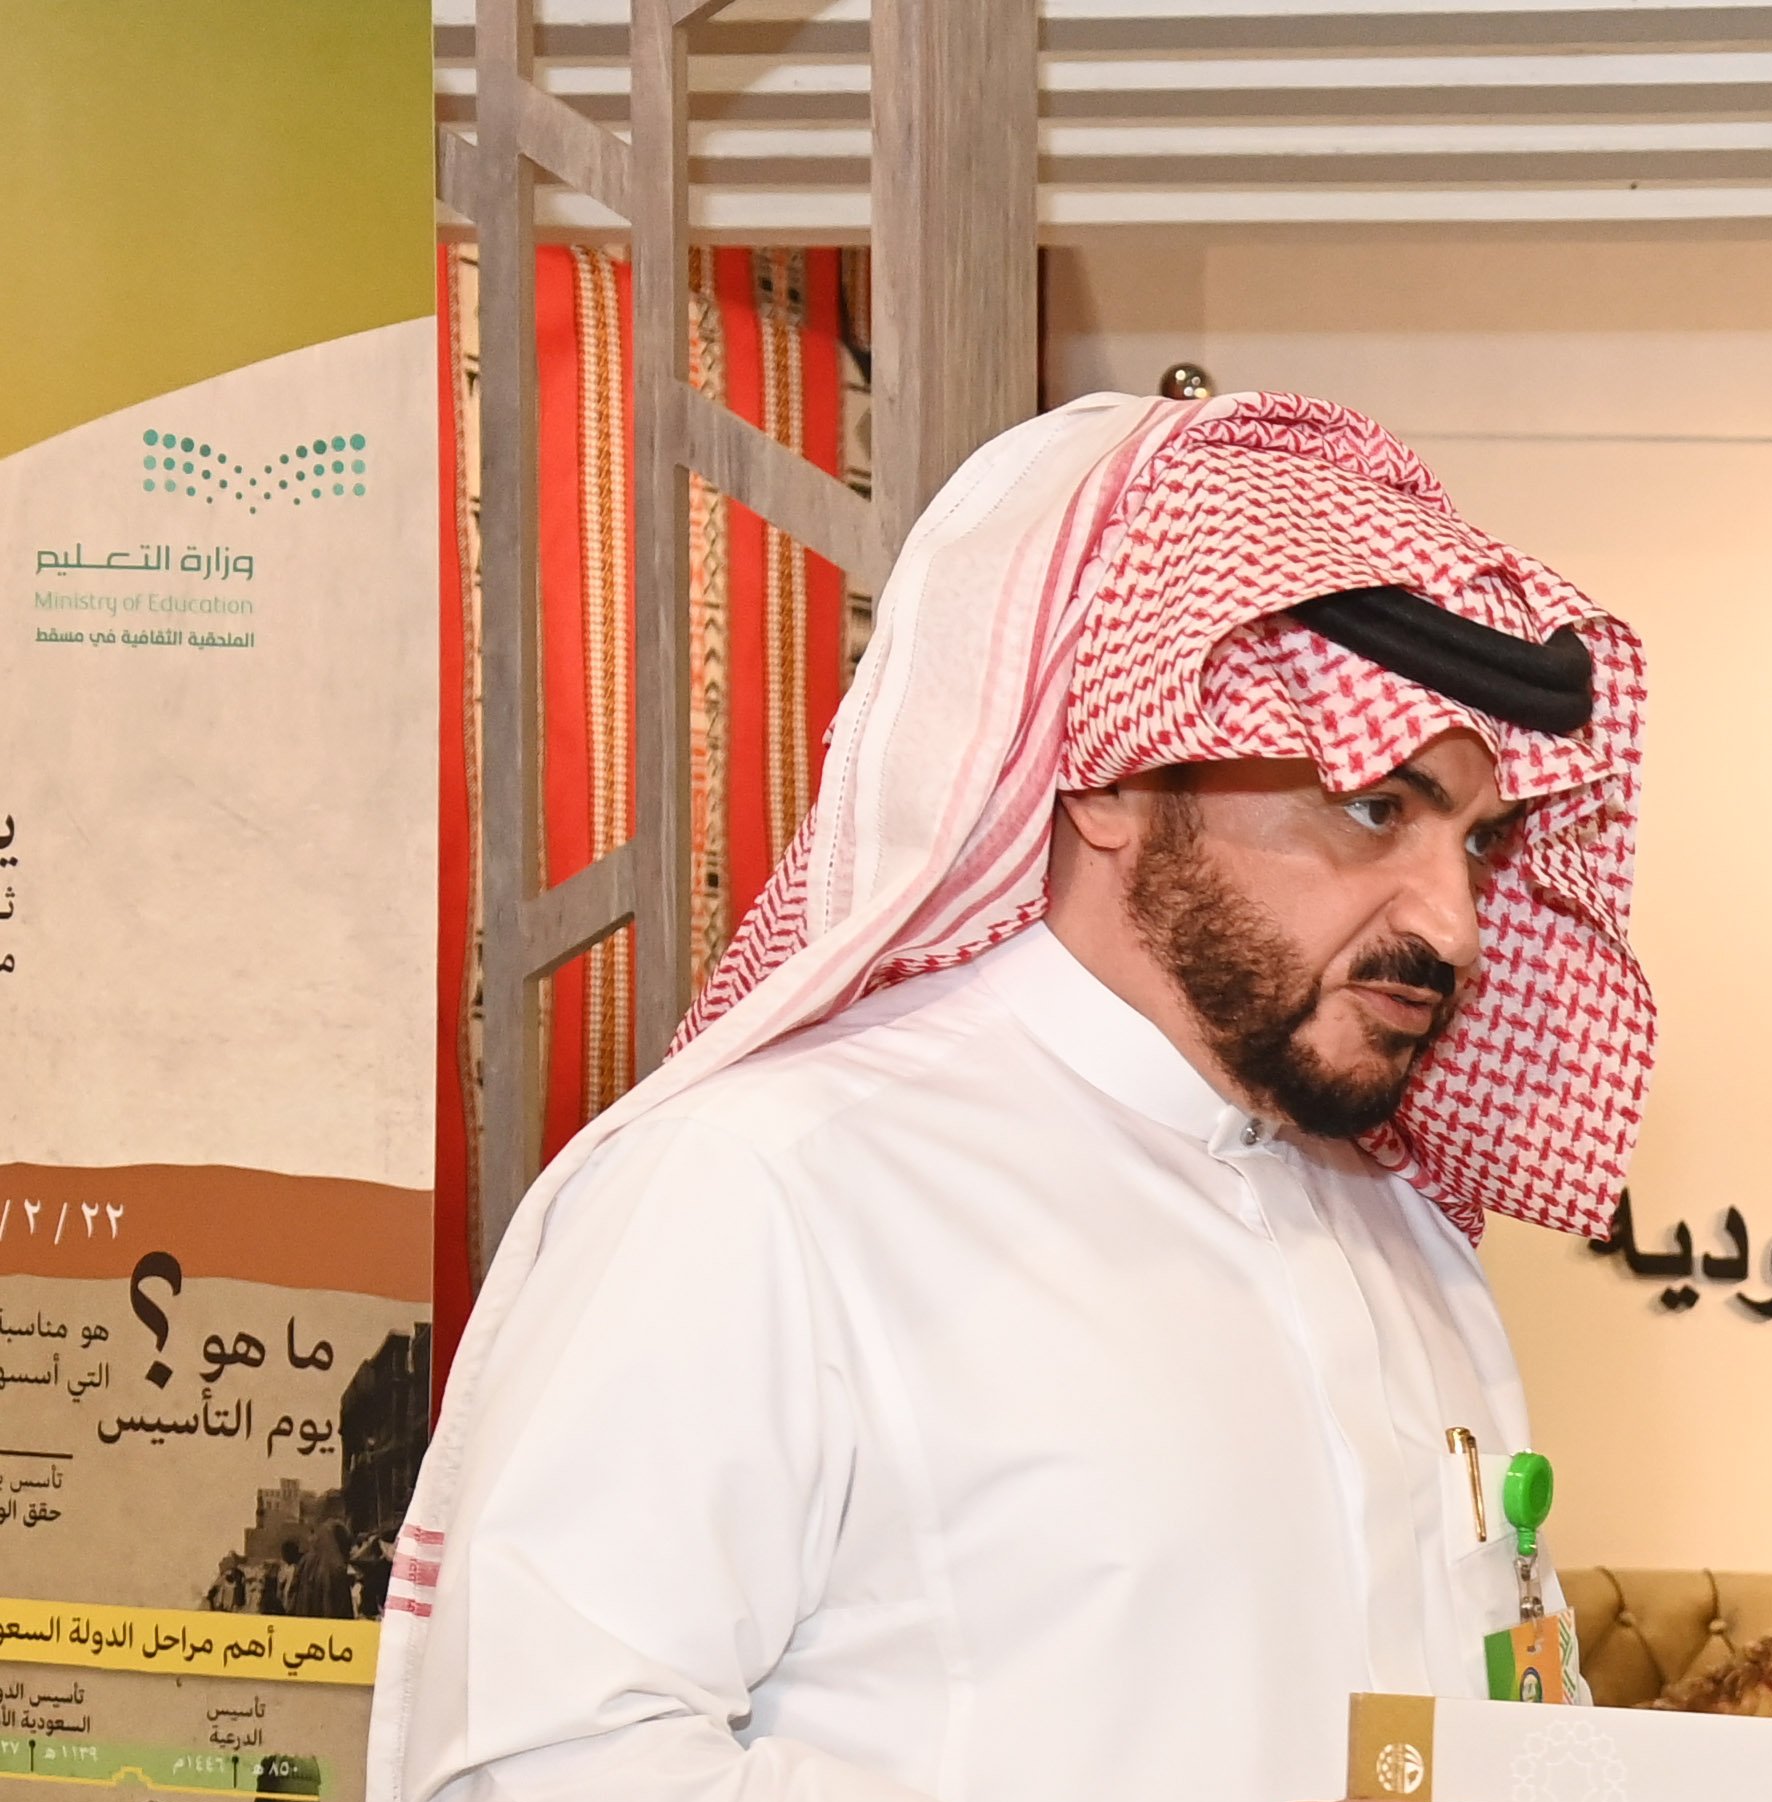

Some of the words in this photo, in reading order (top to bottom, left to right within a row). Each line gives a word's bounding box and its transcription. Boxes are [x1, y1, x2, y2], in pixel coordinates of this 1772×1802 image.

[36, 543, 170, 576] التعليم
[180, 546, 254, 580] وزارة
[35, 591, 117, 616] Ministry
[123, 592, 142, 611] of
[148, 593, 253, 614] Education
[36, 628, 83, 643] مسقط
[90, 630, 115, 646] في
[122, 630, 183, 646] الثقافية
[188, 633, 254, 650] الملحقية
[81, 1323, 109, 1348] هو
[287, 1315, 334, 1370] ما
[200, 1331, 266, 1382] هو
[0, 1353, 59, 1390] أسسه
[67, 1361, 110, 1403] التي
[97, 1387, 252, 1445] التأسيس
[267, 1416, 336, 1458] يوم
[10, 1464, 63, 1493] تأسس
[23, 1502, 62, 1528] حقق
[69, 1617, 133, 1655] الدولة
[142, 1623, 213, 1661] مراحل
[223, 1626, 274, 1666] أهم
[29, 1682, 85, 1707] تأسيس
[207, 1695, 265, 1721] تأسيس
[21, 1710, 90, 1736] السعودية
[209, 1725, 262, 1751] الدرعية
